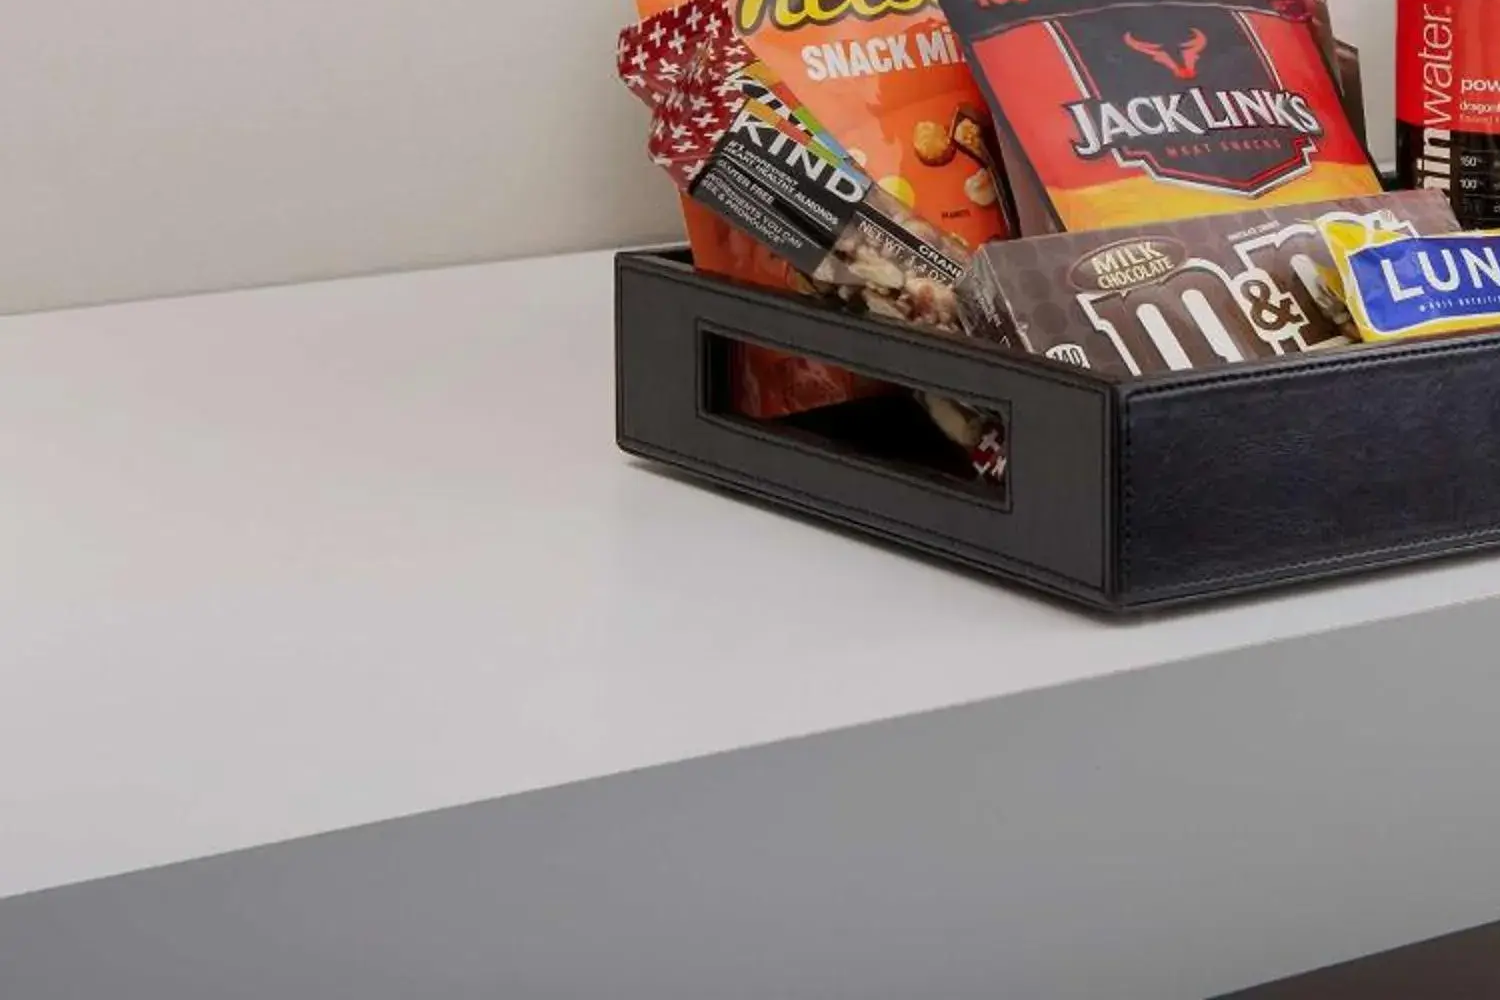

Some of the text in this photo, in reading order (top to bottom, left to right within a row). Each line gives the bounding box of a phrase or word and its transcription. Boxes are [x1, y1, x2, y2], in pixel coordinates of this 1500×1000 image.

[802, 26, 967, 81] SNACK Mi
[1068, 87, 1320, 156] JACK LINK'S
[729, 110, 865, 203] KIND
[748, 182, 775, 205] FREE
[793, 190, 840, 226] ALMONDS
[761, 216, 783, 234] YOU
[858, 220, 882, 241] NET
[917, 244, 962, 278] CRAN
[1091, 241, 1164, 275] MILK
[1096, 255, 1176, 290] CHOCOLATE
